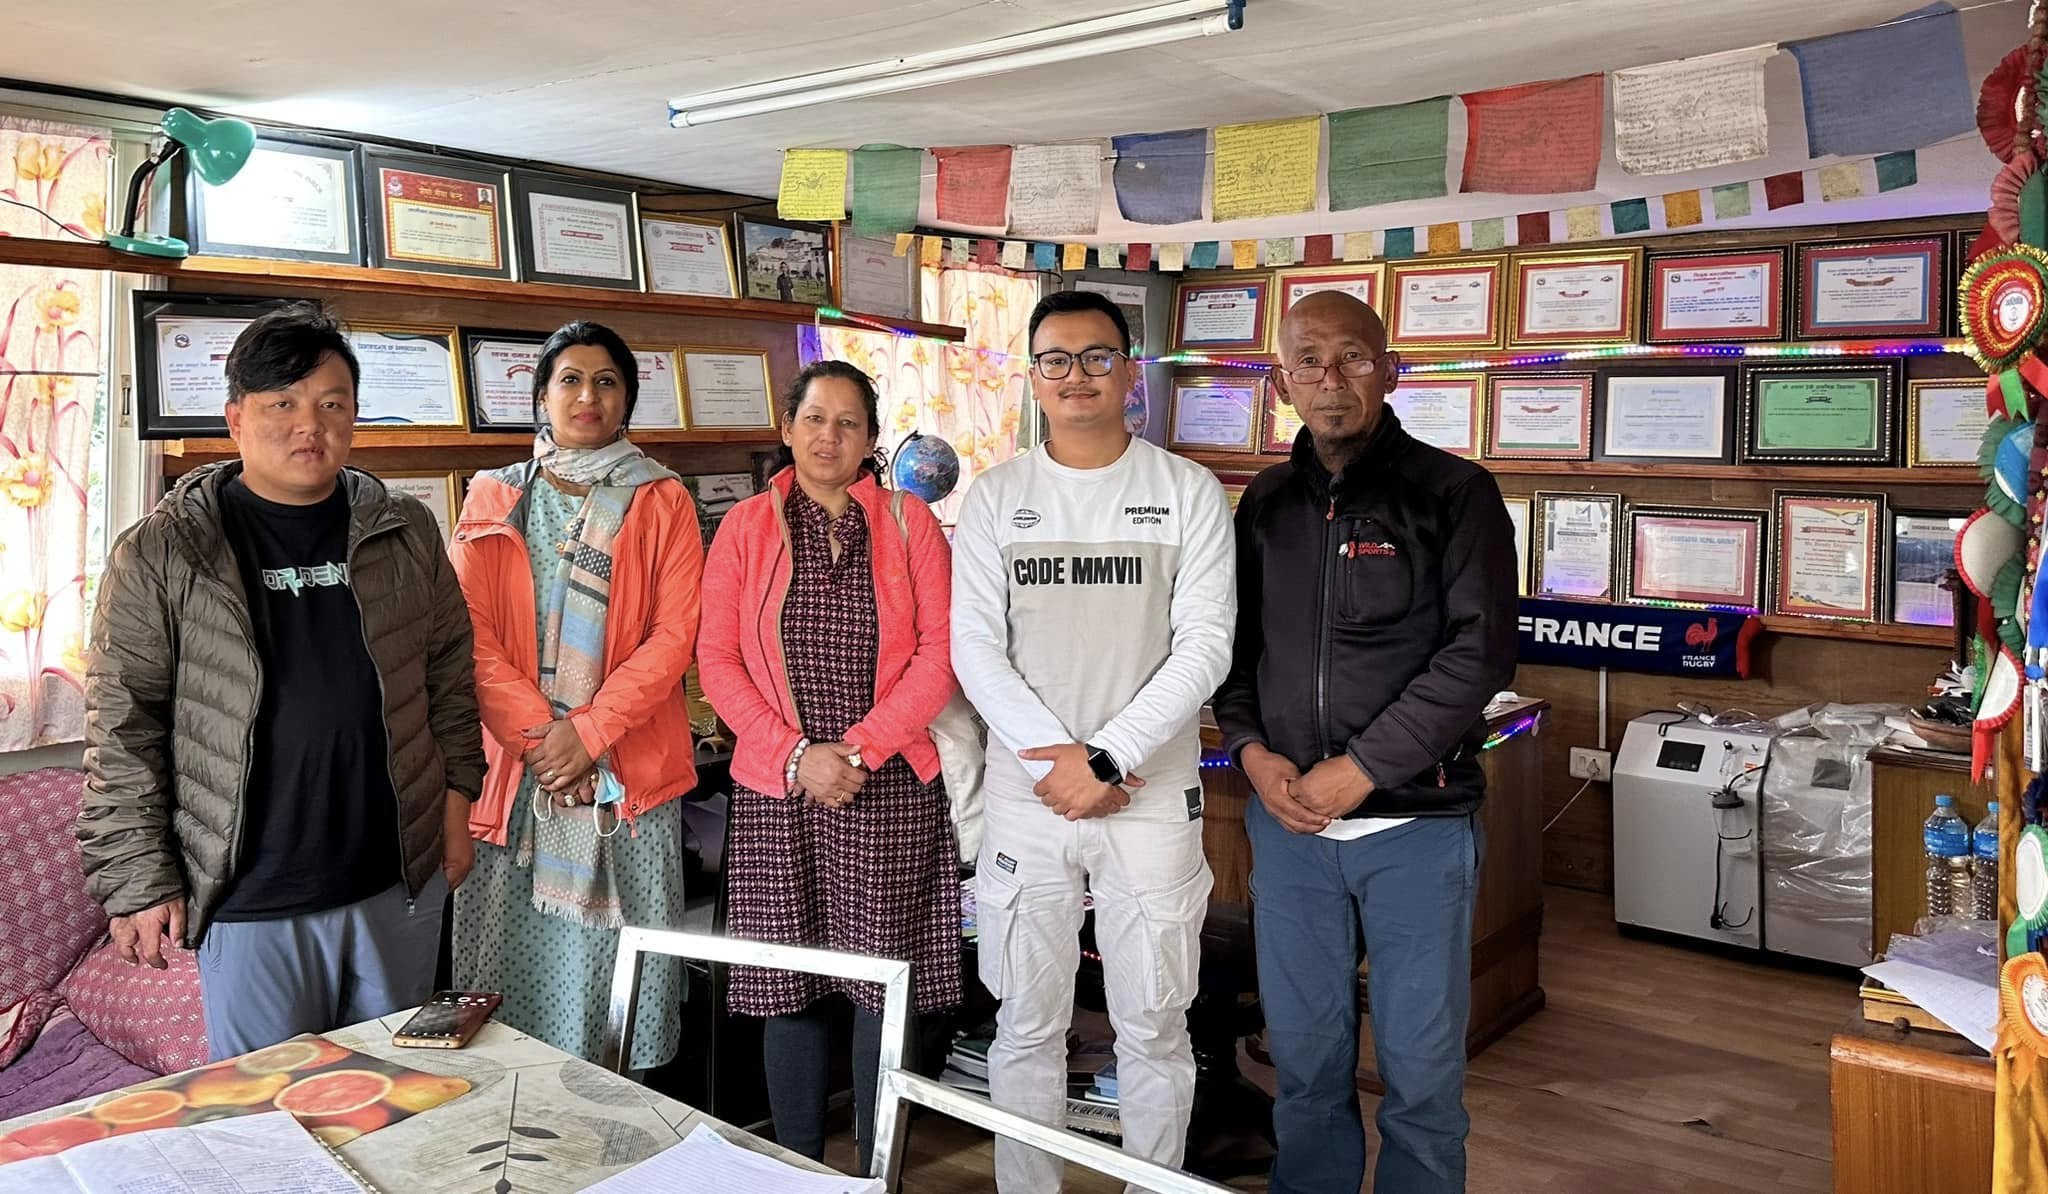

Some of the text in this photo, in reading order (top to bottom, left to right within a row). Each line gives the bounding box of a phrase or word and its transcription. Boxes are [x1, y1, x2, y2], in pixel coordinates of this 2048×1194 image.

[1124, 506, 1170, 516] PREMIUM
[1132, 516, 1162, 525] EDITION
[1013, 556, 1143, 586] CODE MMVII
